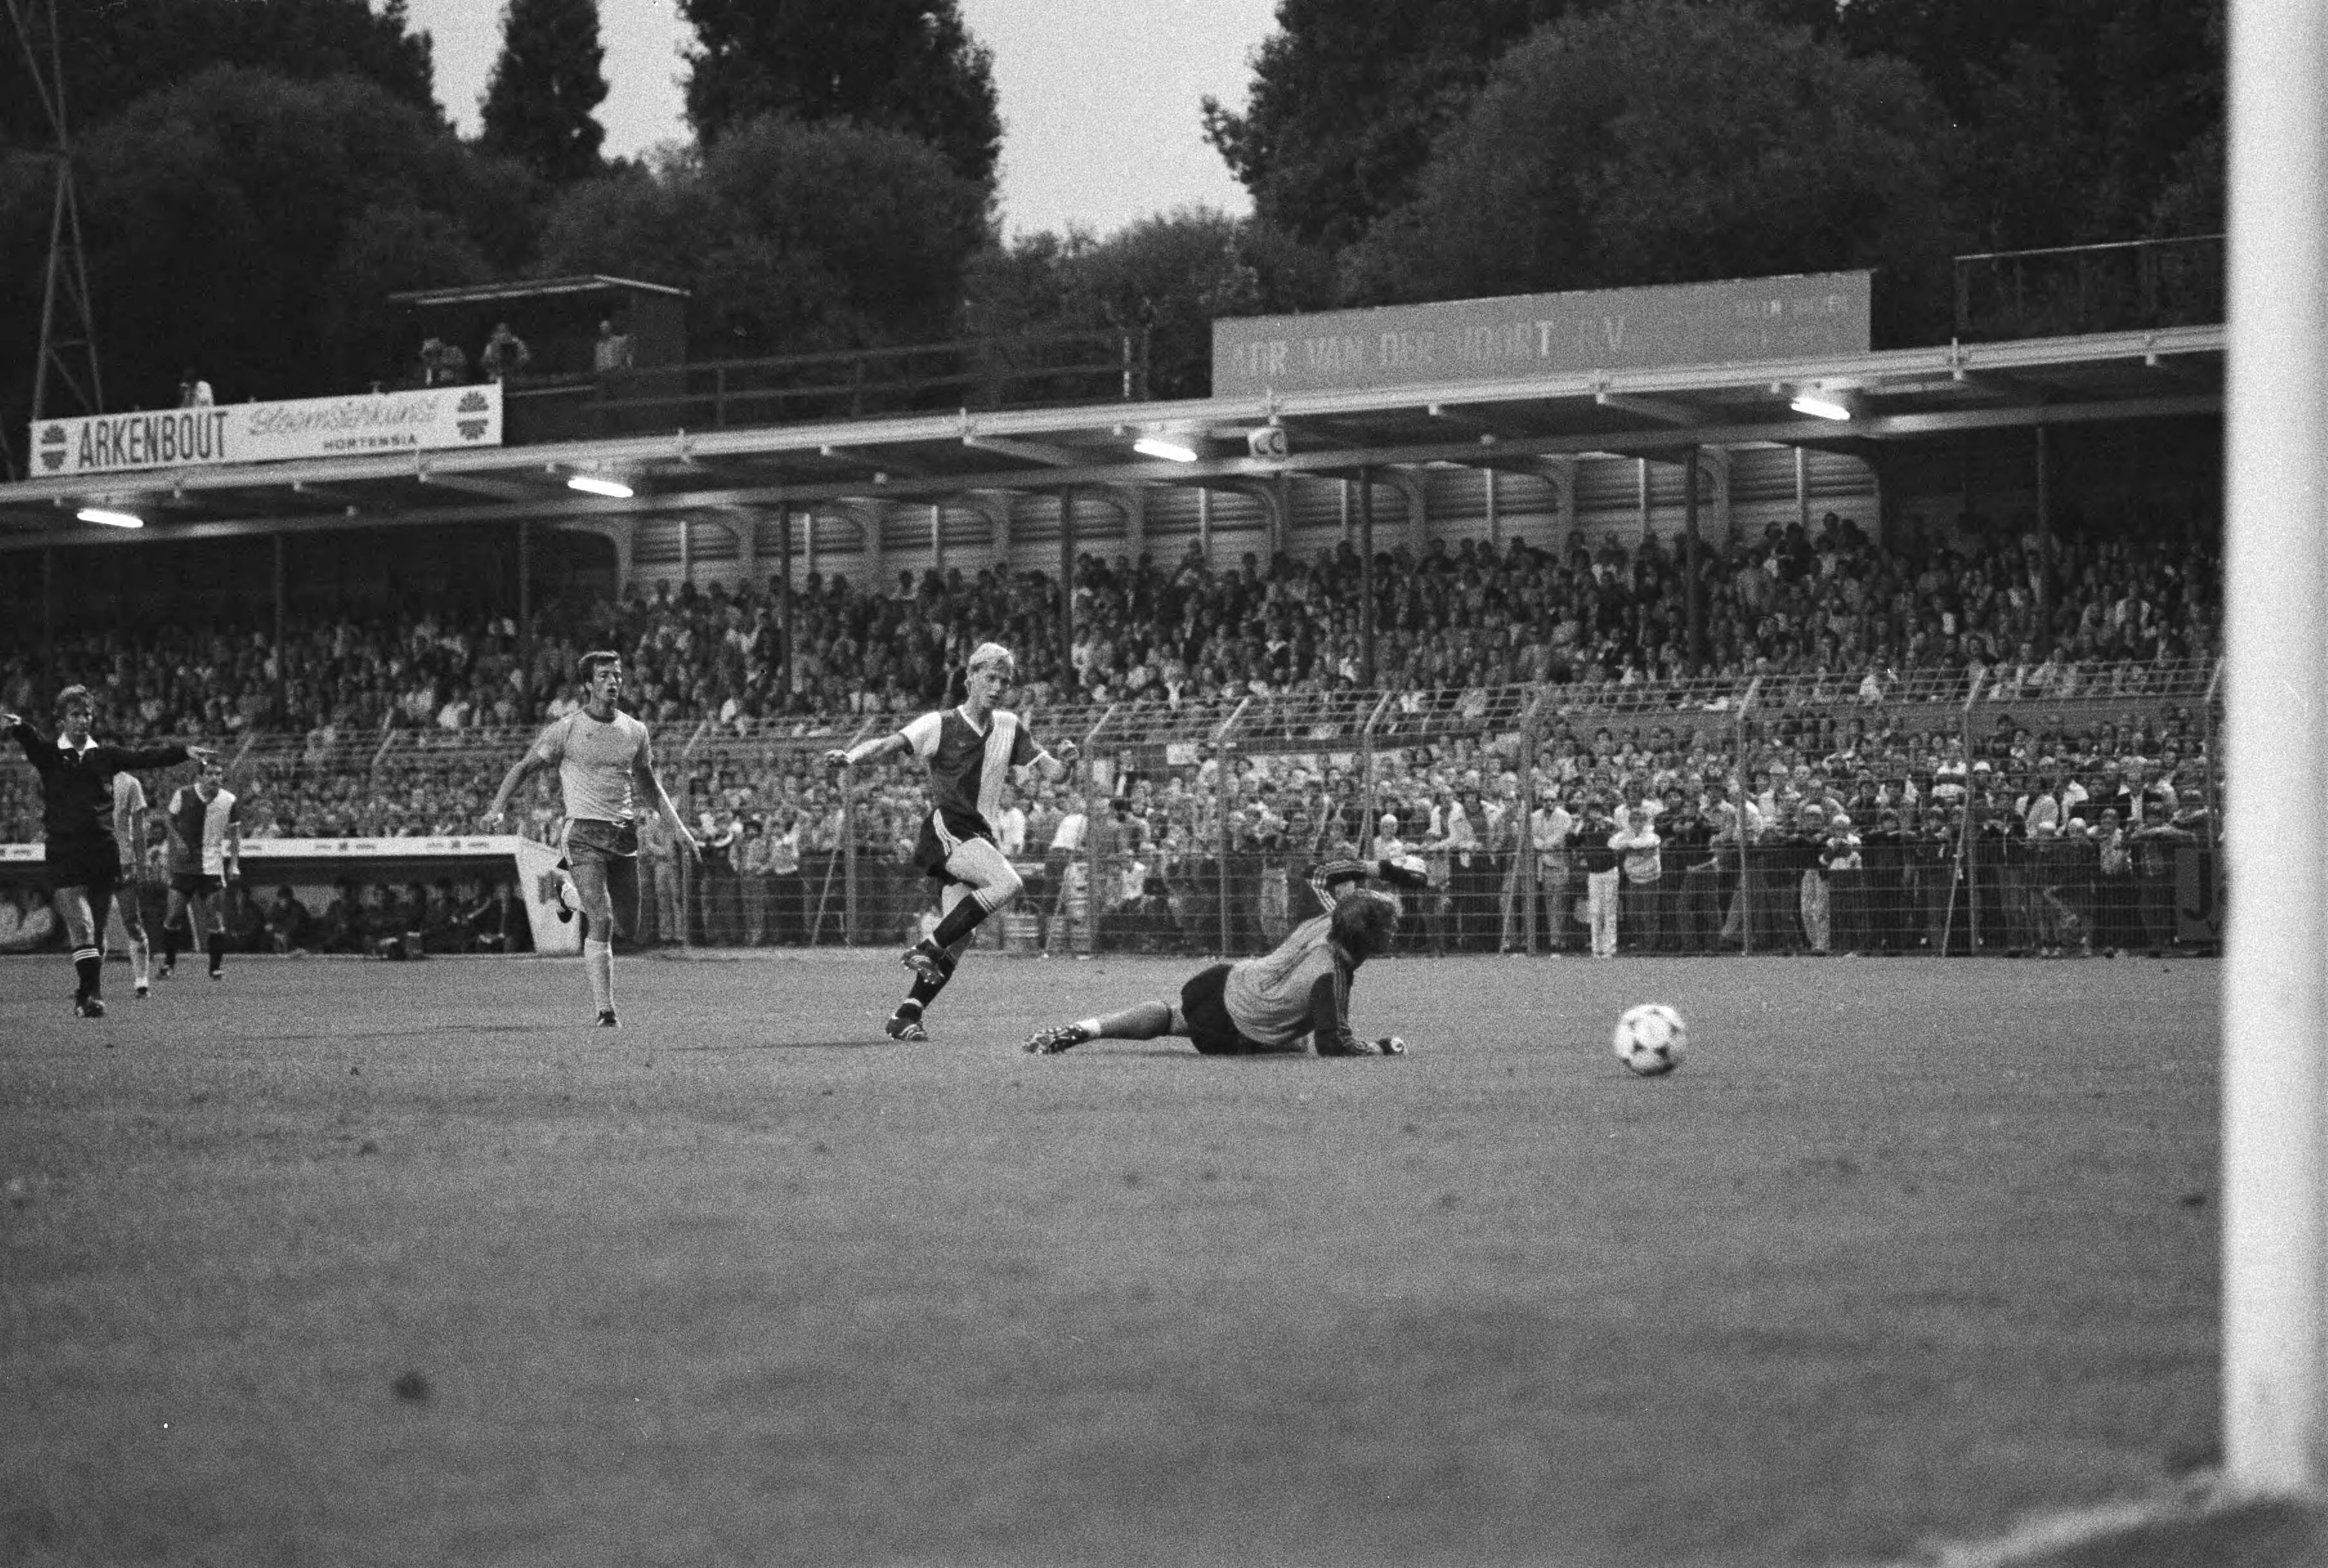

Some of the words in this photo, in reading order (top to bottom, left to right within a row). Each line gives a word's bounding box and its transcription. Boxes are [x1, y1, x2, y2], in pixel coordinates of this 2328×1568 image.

[1304, 335, 1364, 373] VAN
[79, 411, 229, 468] ARKENBOUT
[324, 433, 416, 449] HORTENSIA
